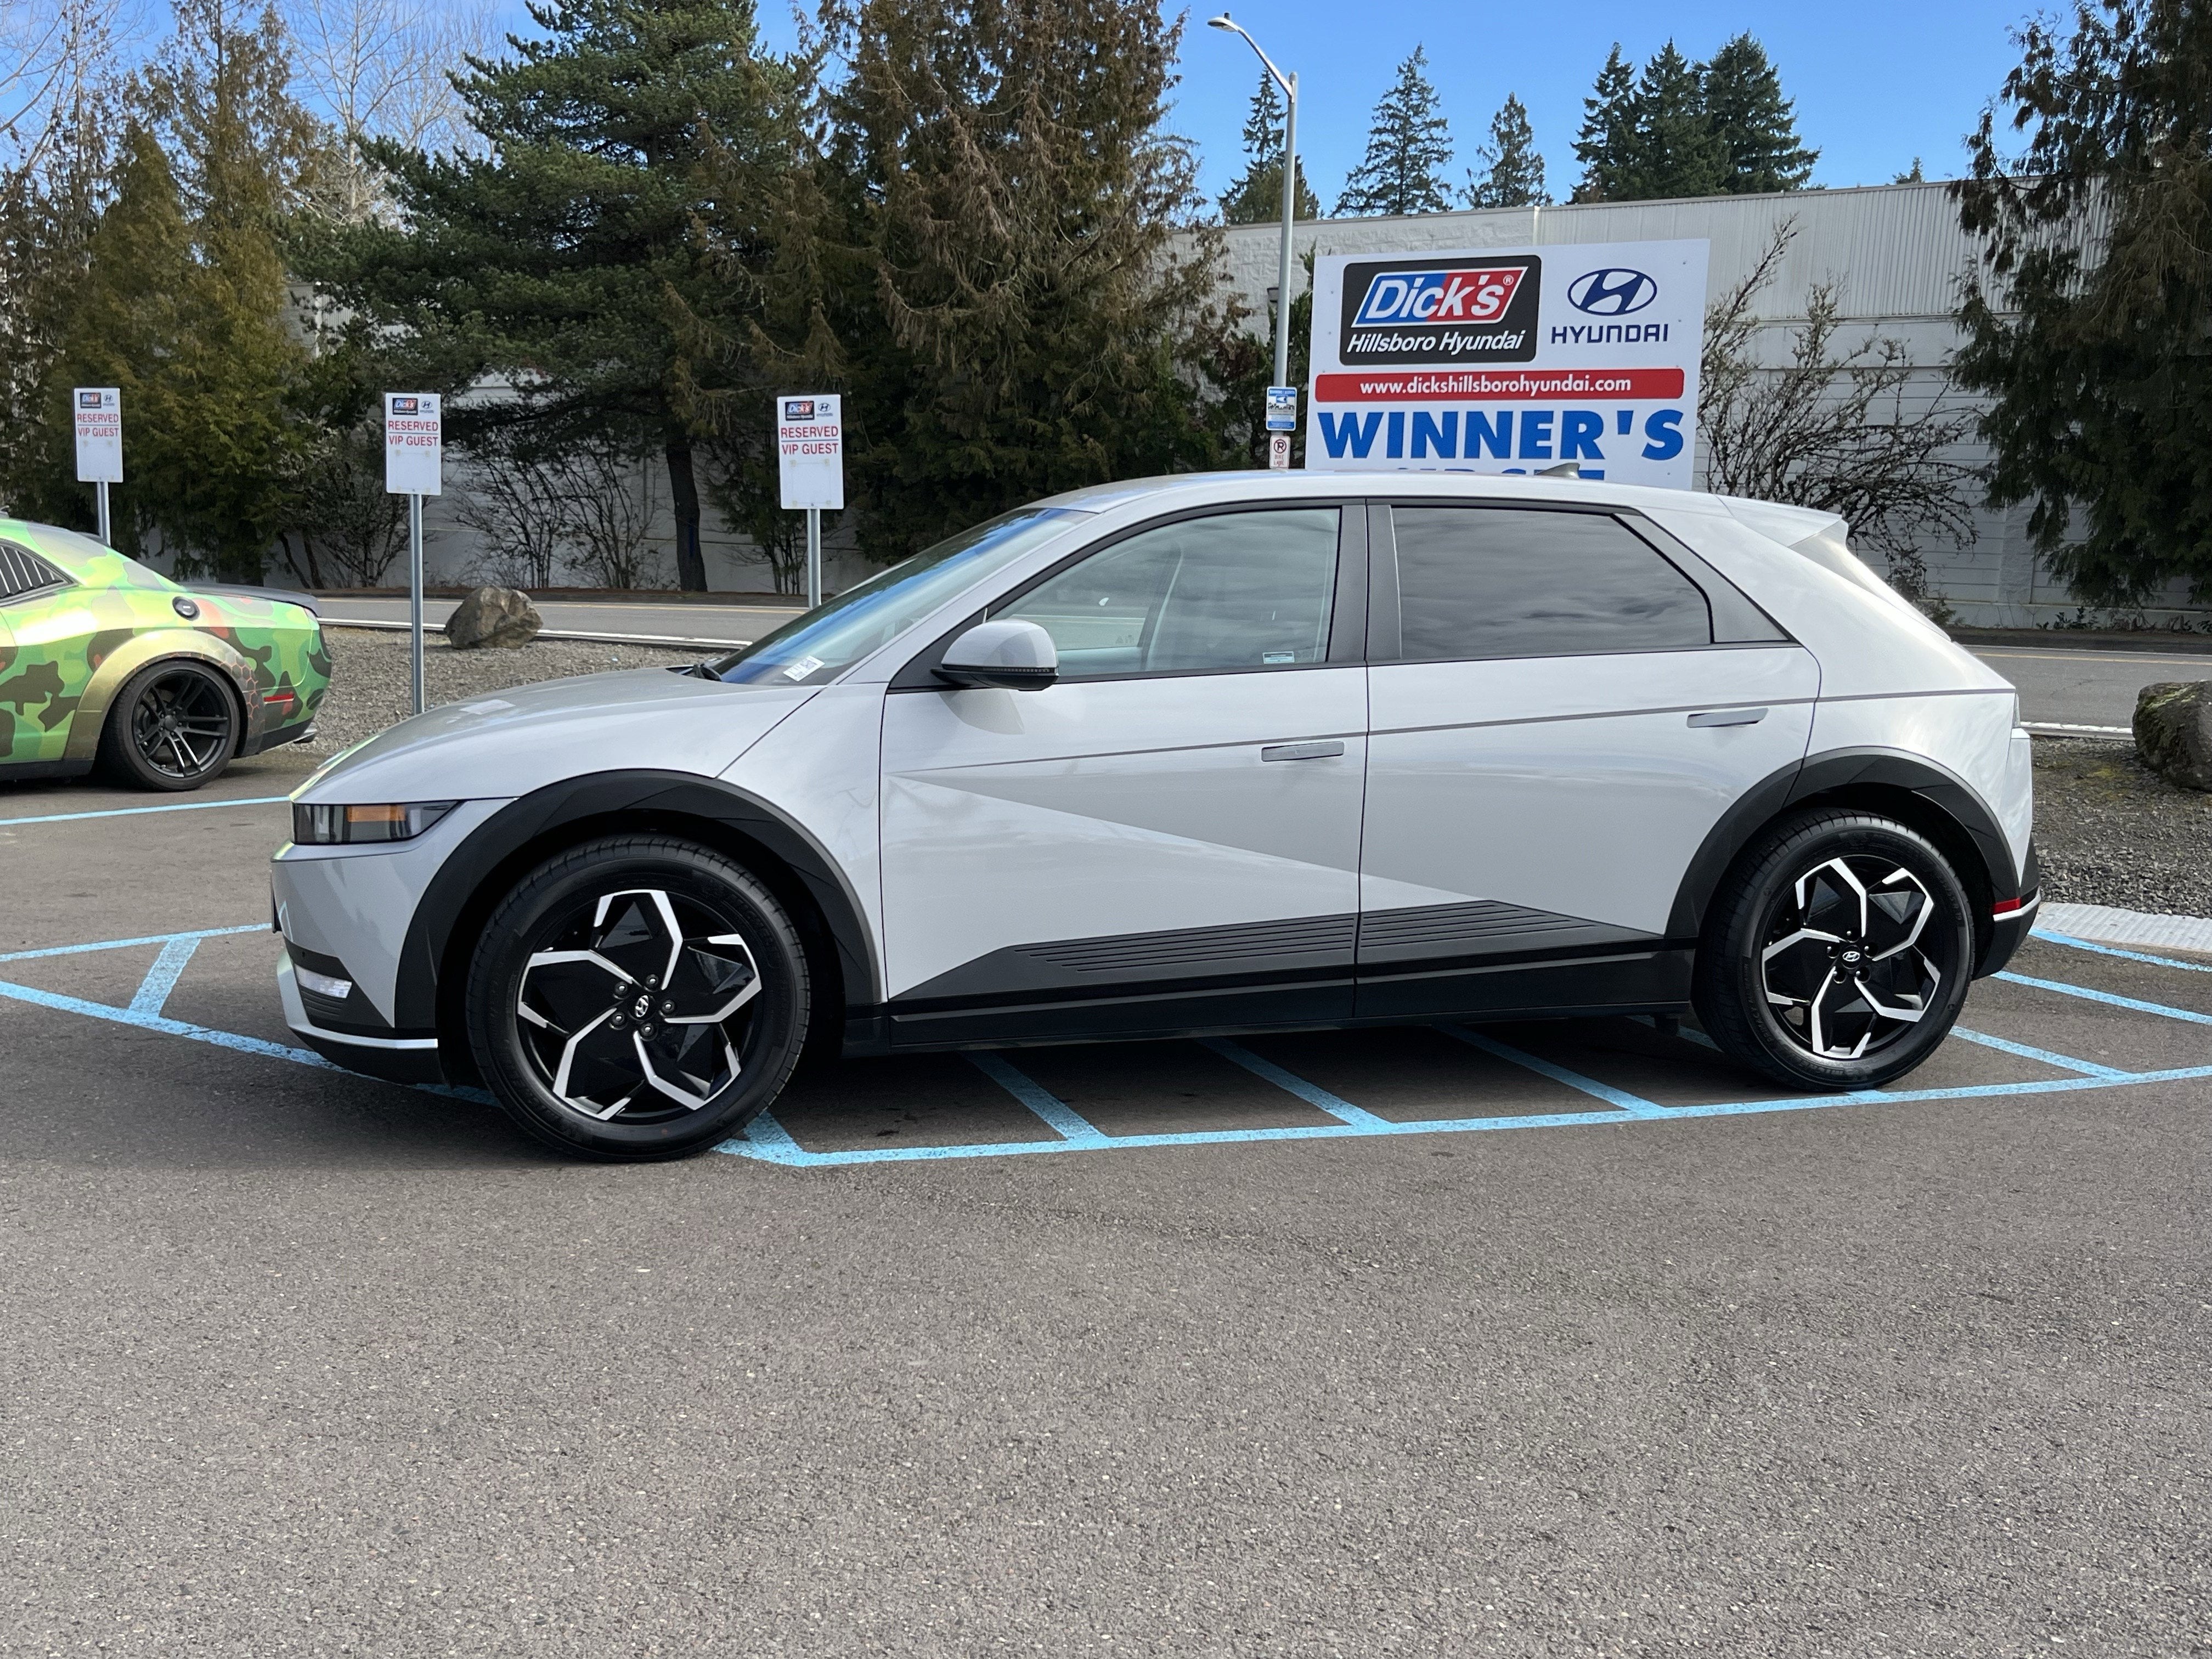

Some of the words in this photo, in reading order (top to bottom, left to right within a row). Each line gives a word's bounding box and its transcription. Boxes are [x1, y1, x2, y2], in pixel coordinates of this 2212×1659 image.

[1365, 275, 1505, 319] Dick's
[1551, 324, 1669, 344] HYUNDAI
[1347, 332, 1436, 353] Hillsboro
[1438, 330, 1526, 356] Hyundai
[1360, 374, 1631, 397] www.dickshillsborohyundai.com
[77, 414, 119, 424] RESERVED
[388, 420, 438, 431] RESERVED
[78, 427, 90, 437] VIP
[92, 427, 119, 437] GUEST
[781, 426, 838, 438] RESERVED
[1317, 409, 1684, 461] WINNER'S
[389, 435, 403, 445] VIP
[406, 436, 438, 447] GUEST
[782, 444, 798, 455] VIP
[802, 443, 839, 454] GUEST
